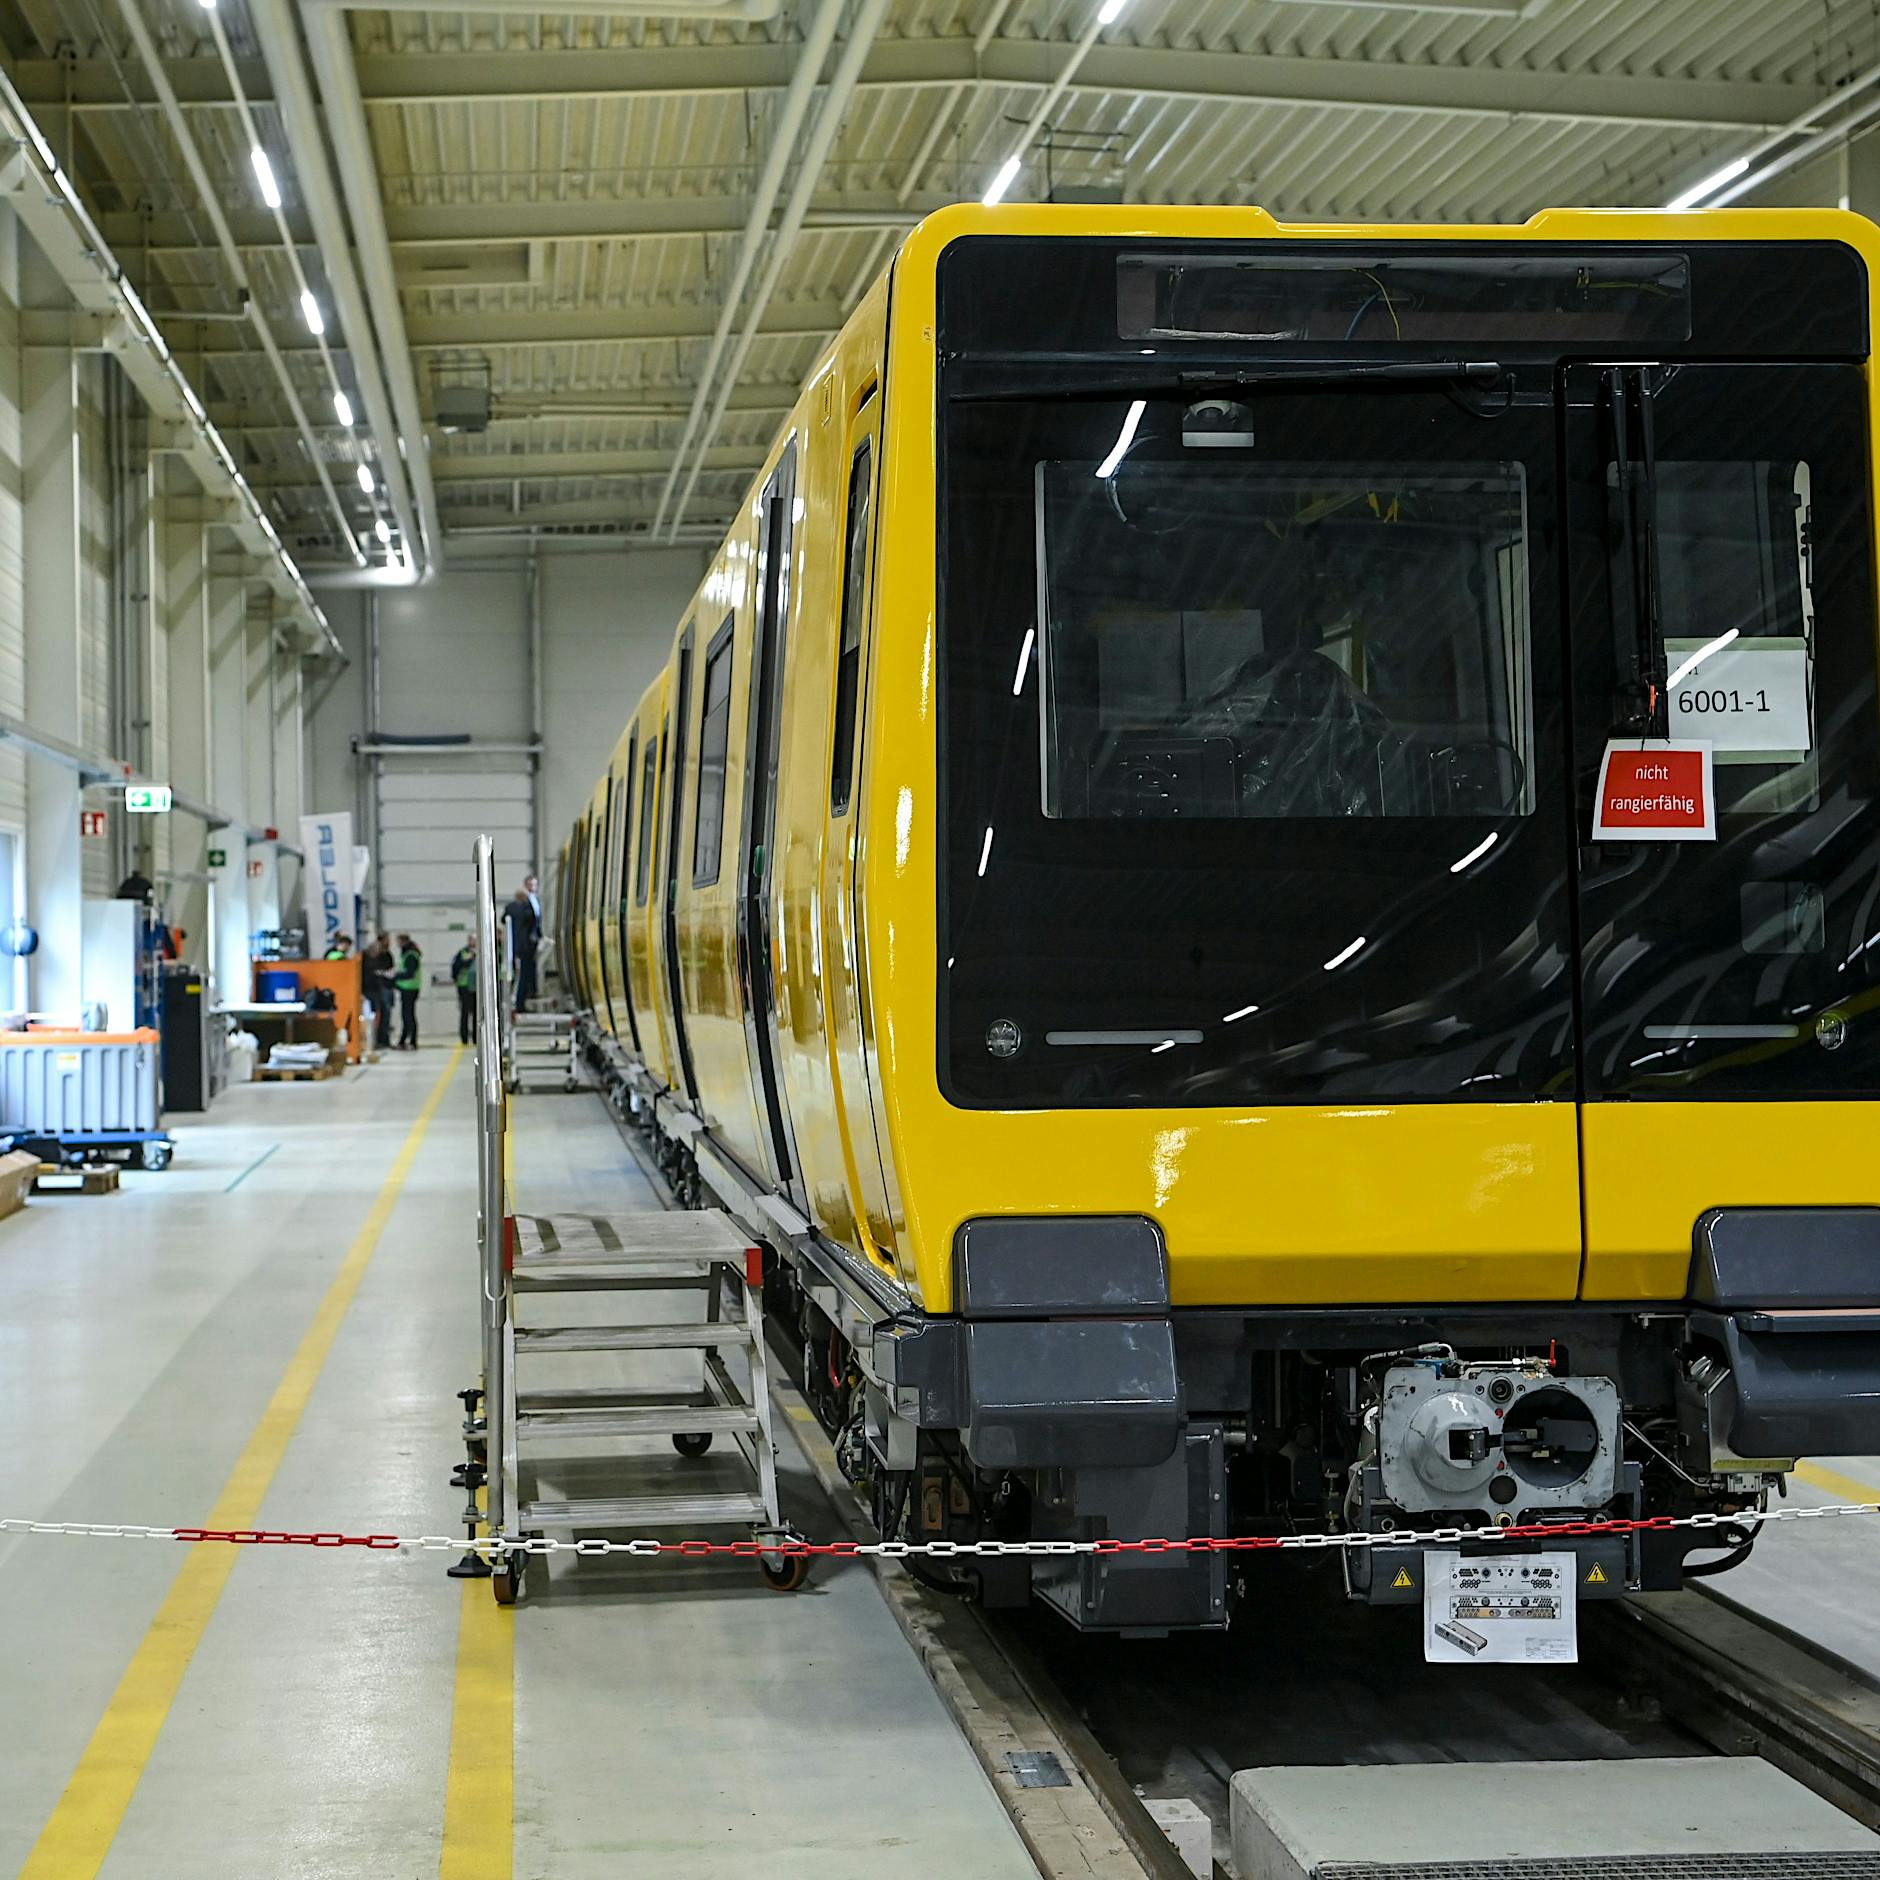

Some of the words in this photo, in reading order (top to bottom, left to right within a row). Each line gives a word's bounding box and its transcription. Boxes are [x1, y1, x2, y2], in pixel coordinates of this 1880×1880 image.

[1678, 690, 1771, 713] 6001-1
[1635, 764, 1669, 780] nicht
[1611, 795, 1695, 813] rangierfähig
